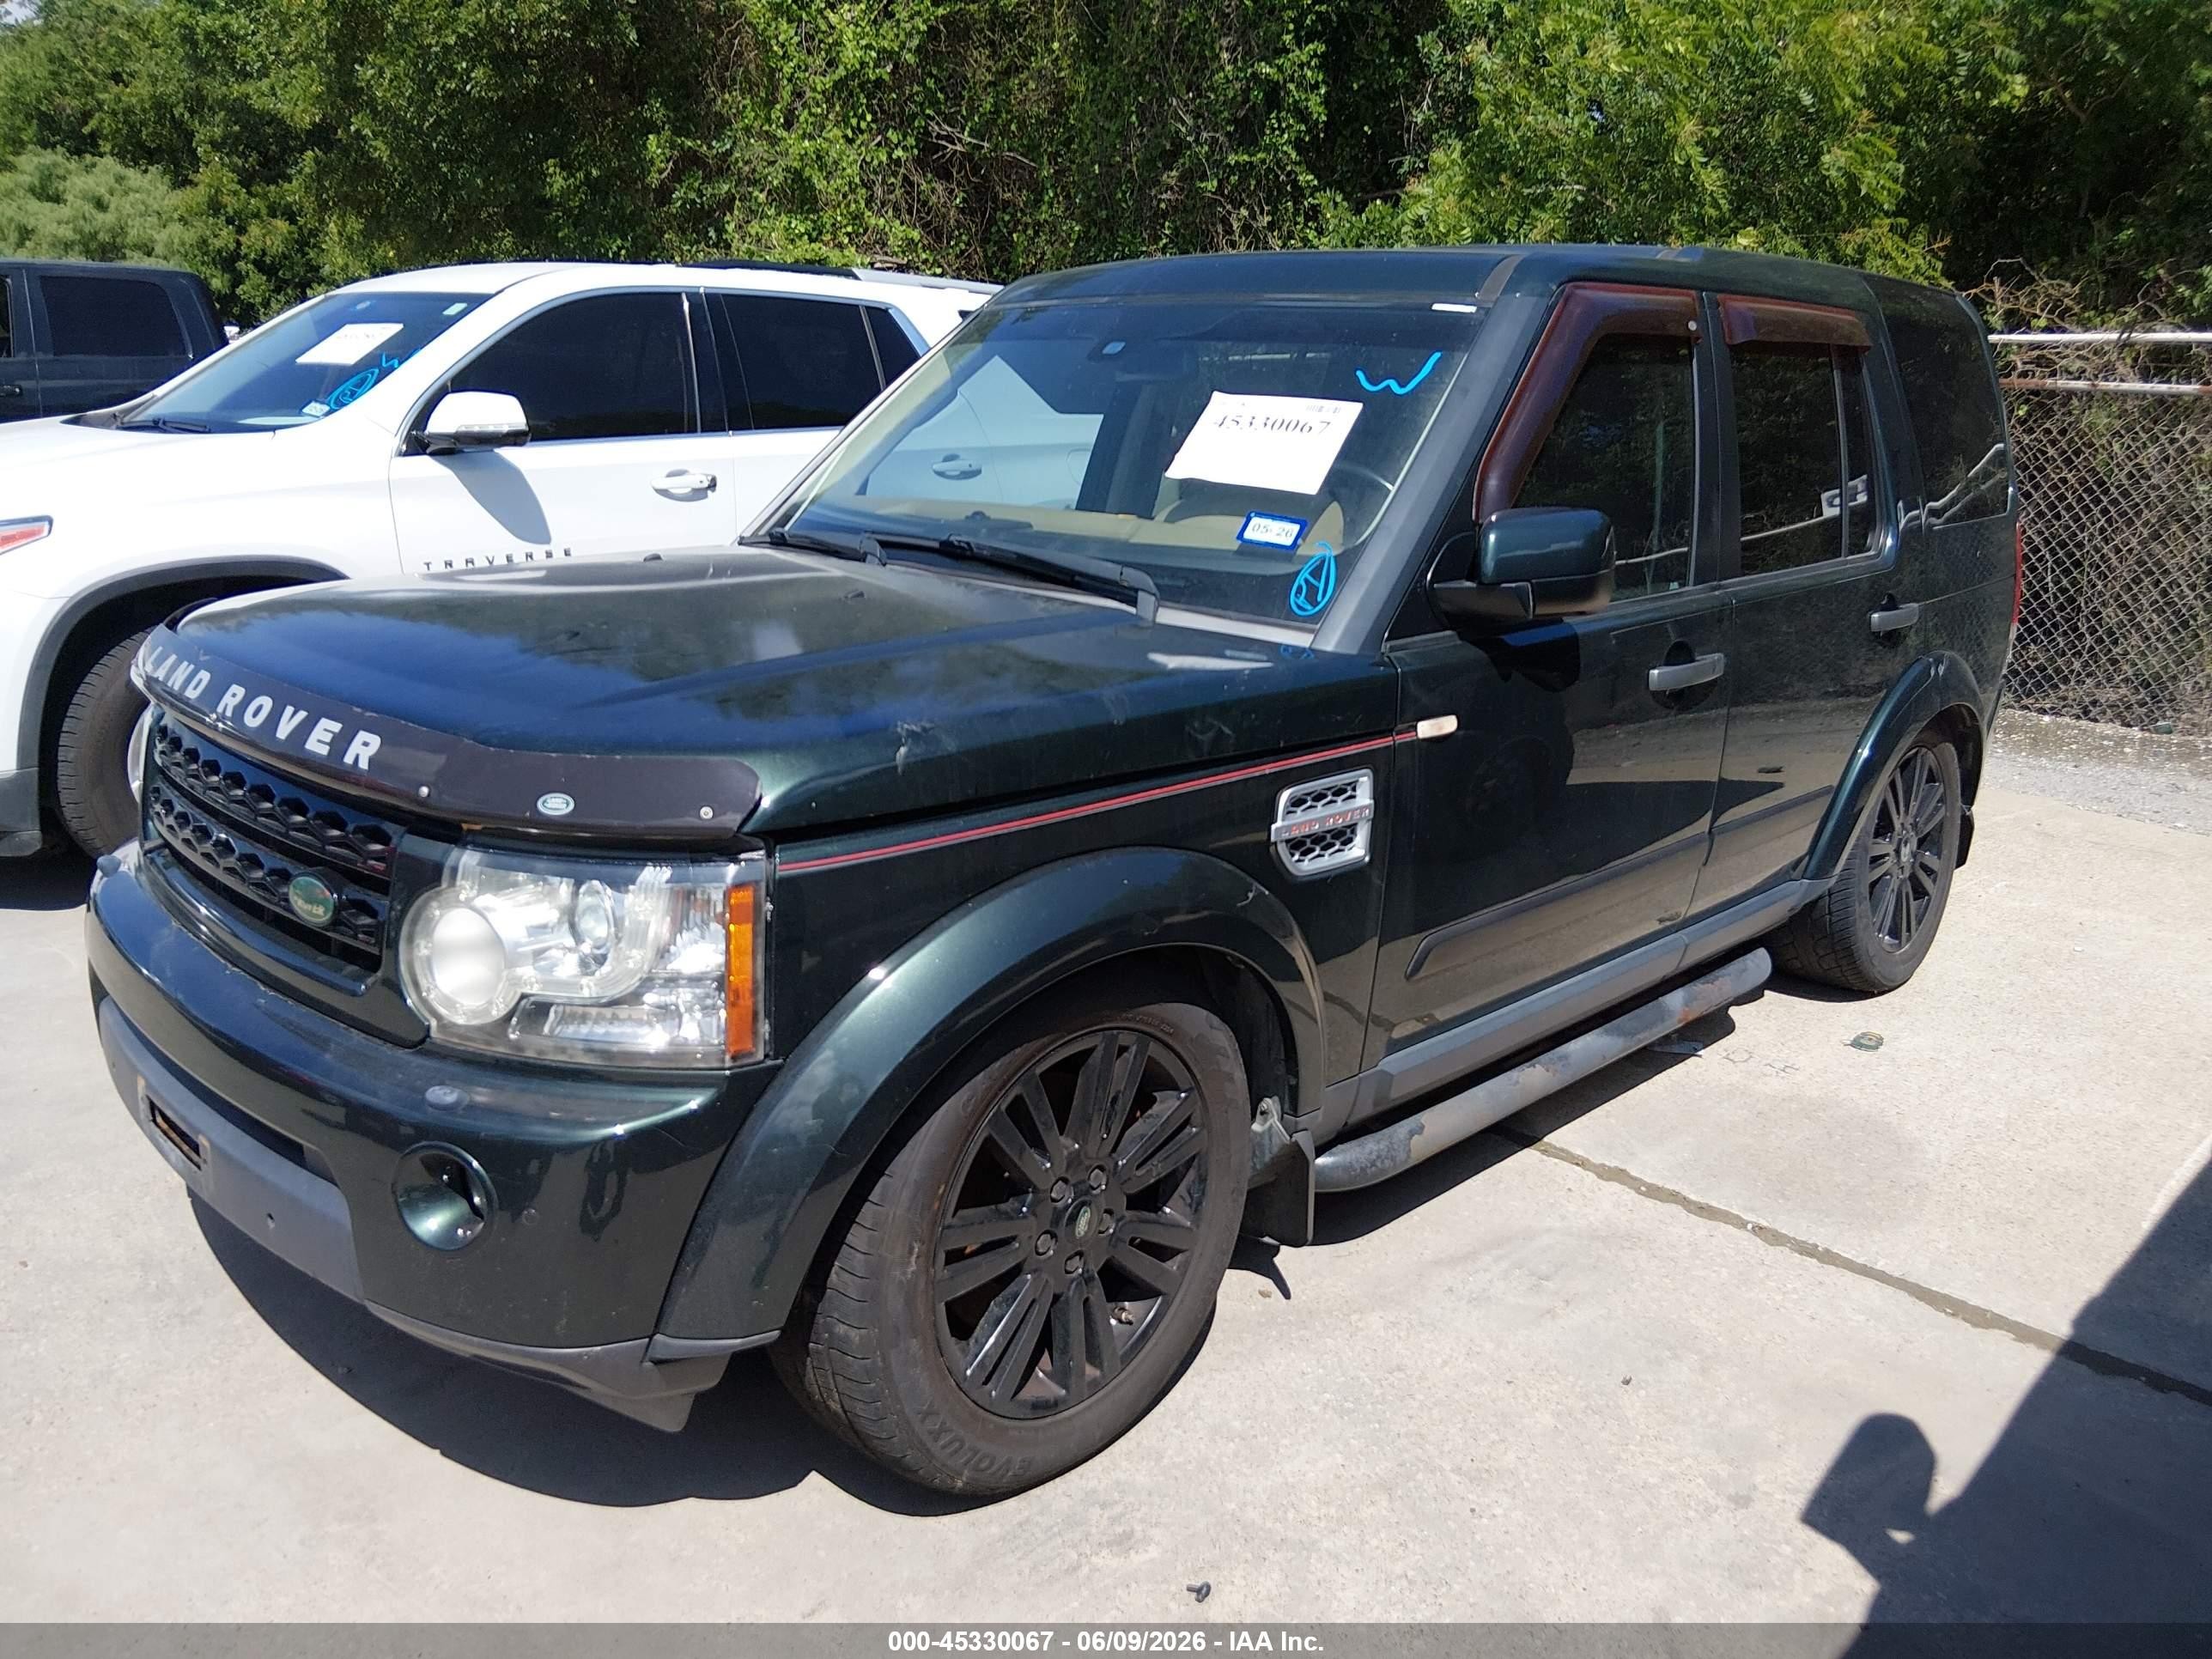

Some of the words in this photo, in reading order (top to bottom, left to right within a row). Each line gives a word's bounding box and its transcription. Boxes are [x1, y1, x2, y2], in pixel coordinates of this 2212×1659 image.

[1215, 414, 1331, 434] 45330067
[424, 548, 571, 571] TRAVERSE
[145, 647, 211, 699] LAND
[216, 684, 382, 770] ROVER
